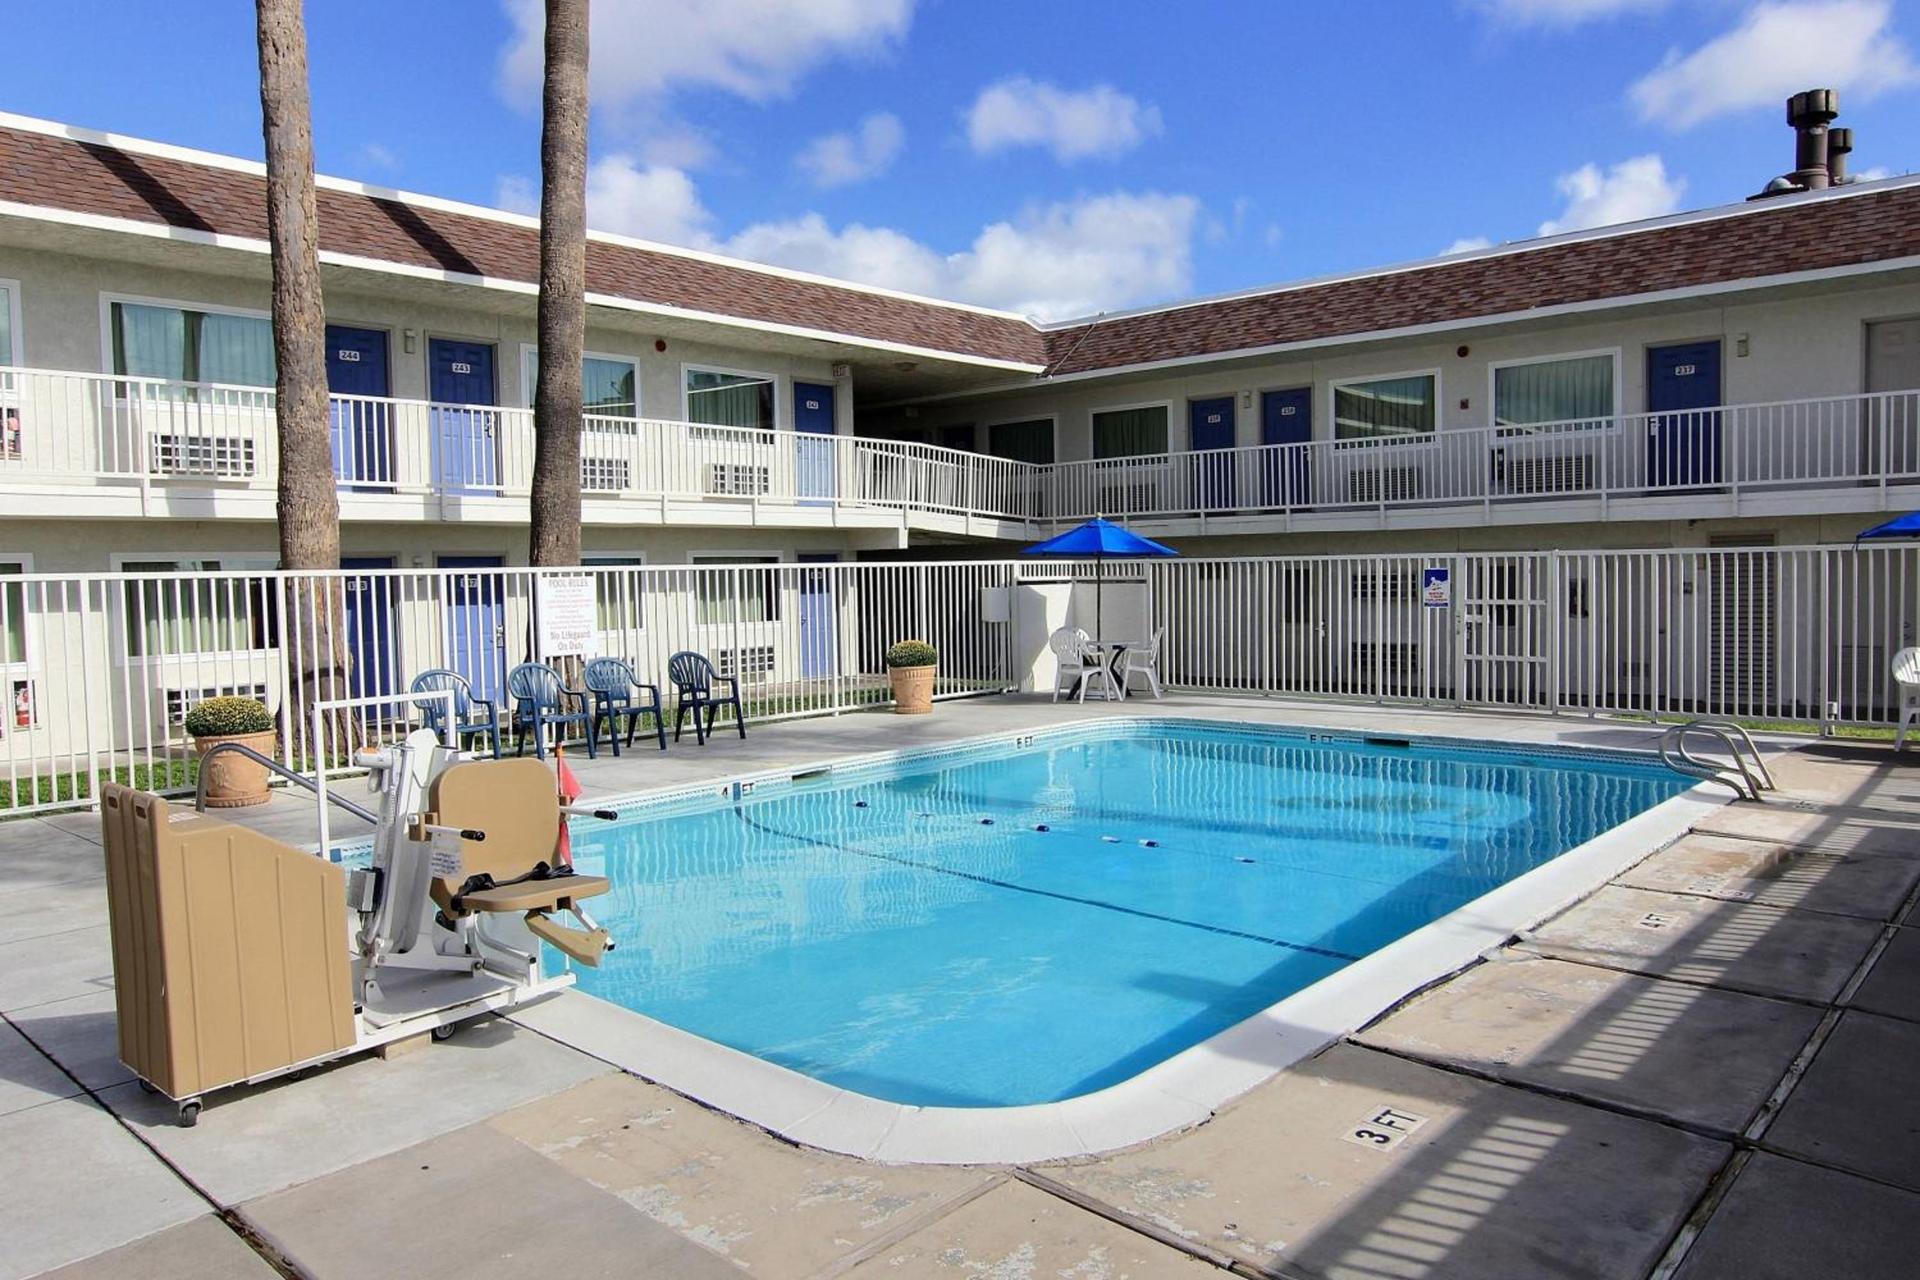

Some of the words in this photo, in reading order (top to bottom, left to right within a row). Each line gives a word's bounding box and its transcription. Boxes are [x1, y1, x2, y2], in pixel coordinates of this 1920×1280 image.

[341, 351, 358, 359] 244
[549, 579, 566, 588] POOL
[568, 578, 589, 587] RULES
[550, 632, 560, 640] No
[561, 631, 591, 641] Lifeguard
[558, 642, 568, 650] On
[569, 641, 584, 650] Duty
[742, 782, 754, 796] FT
[1645, 913, 1673, 922] FT
[1372, 1109, 1417, 1131] FT
[1355, 1129, 1391, 1144] 3
